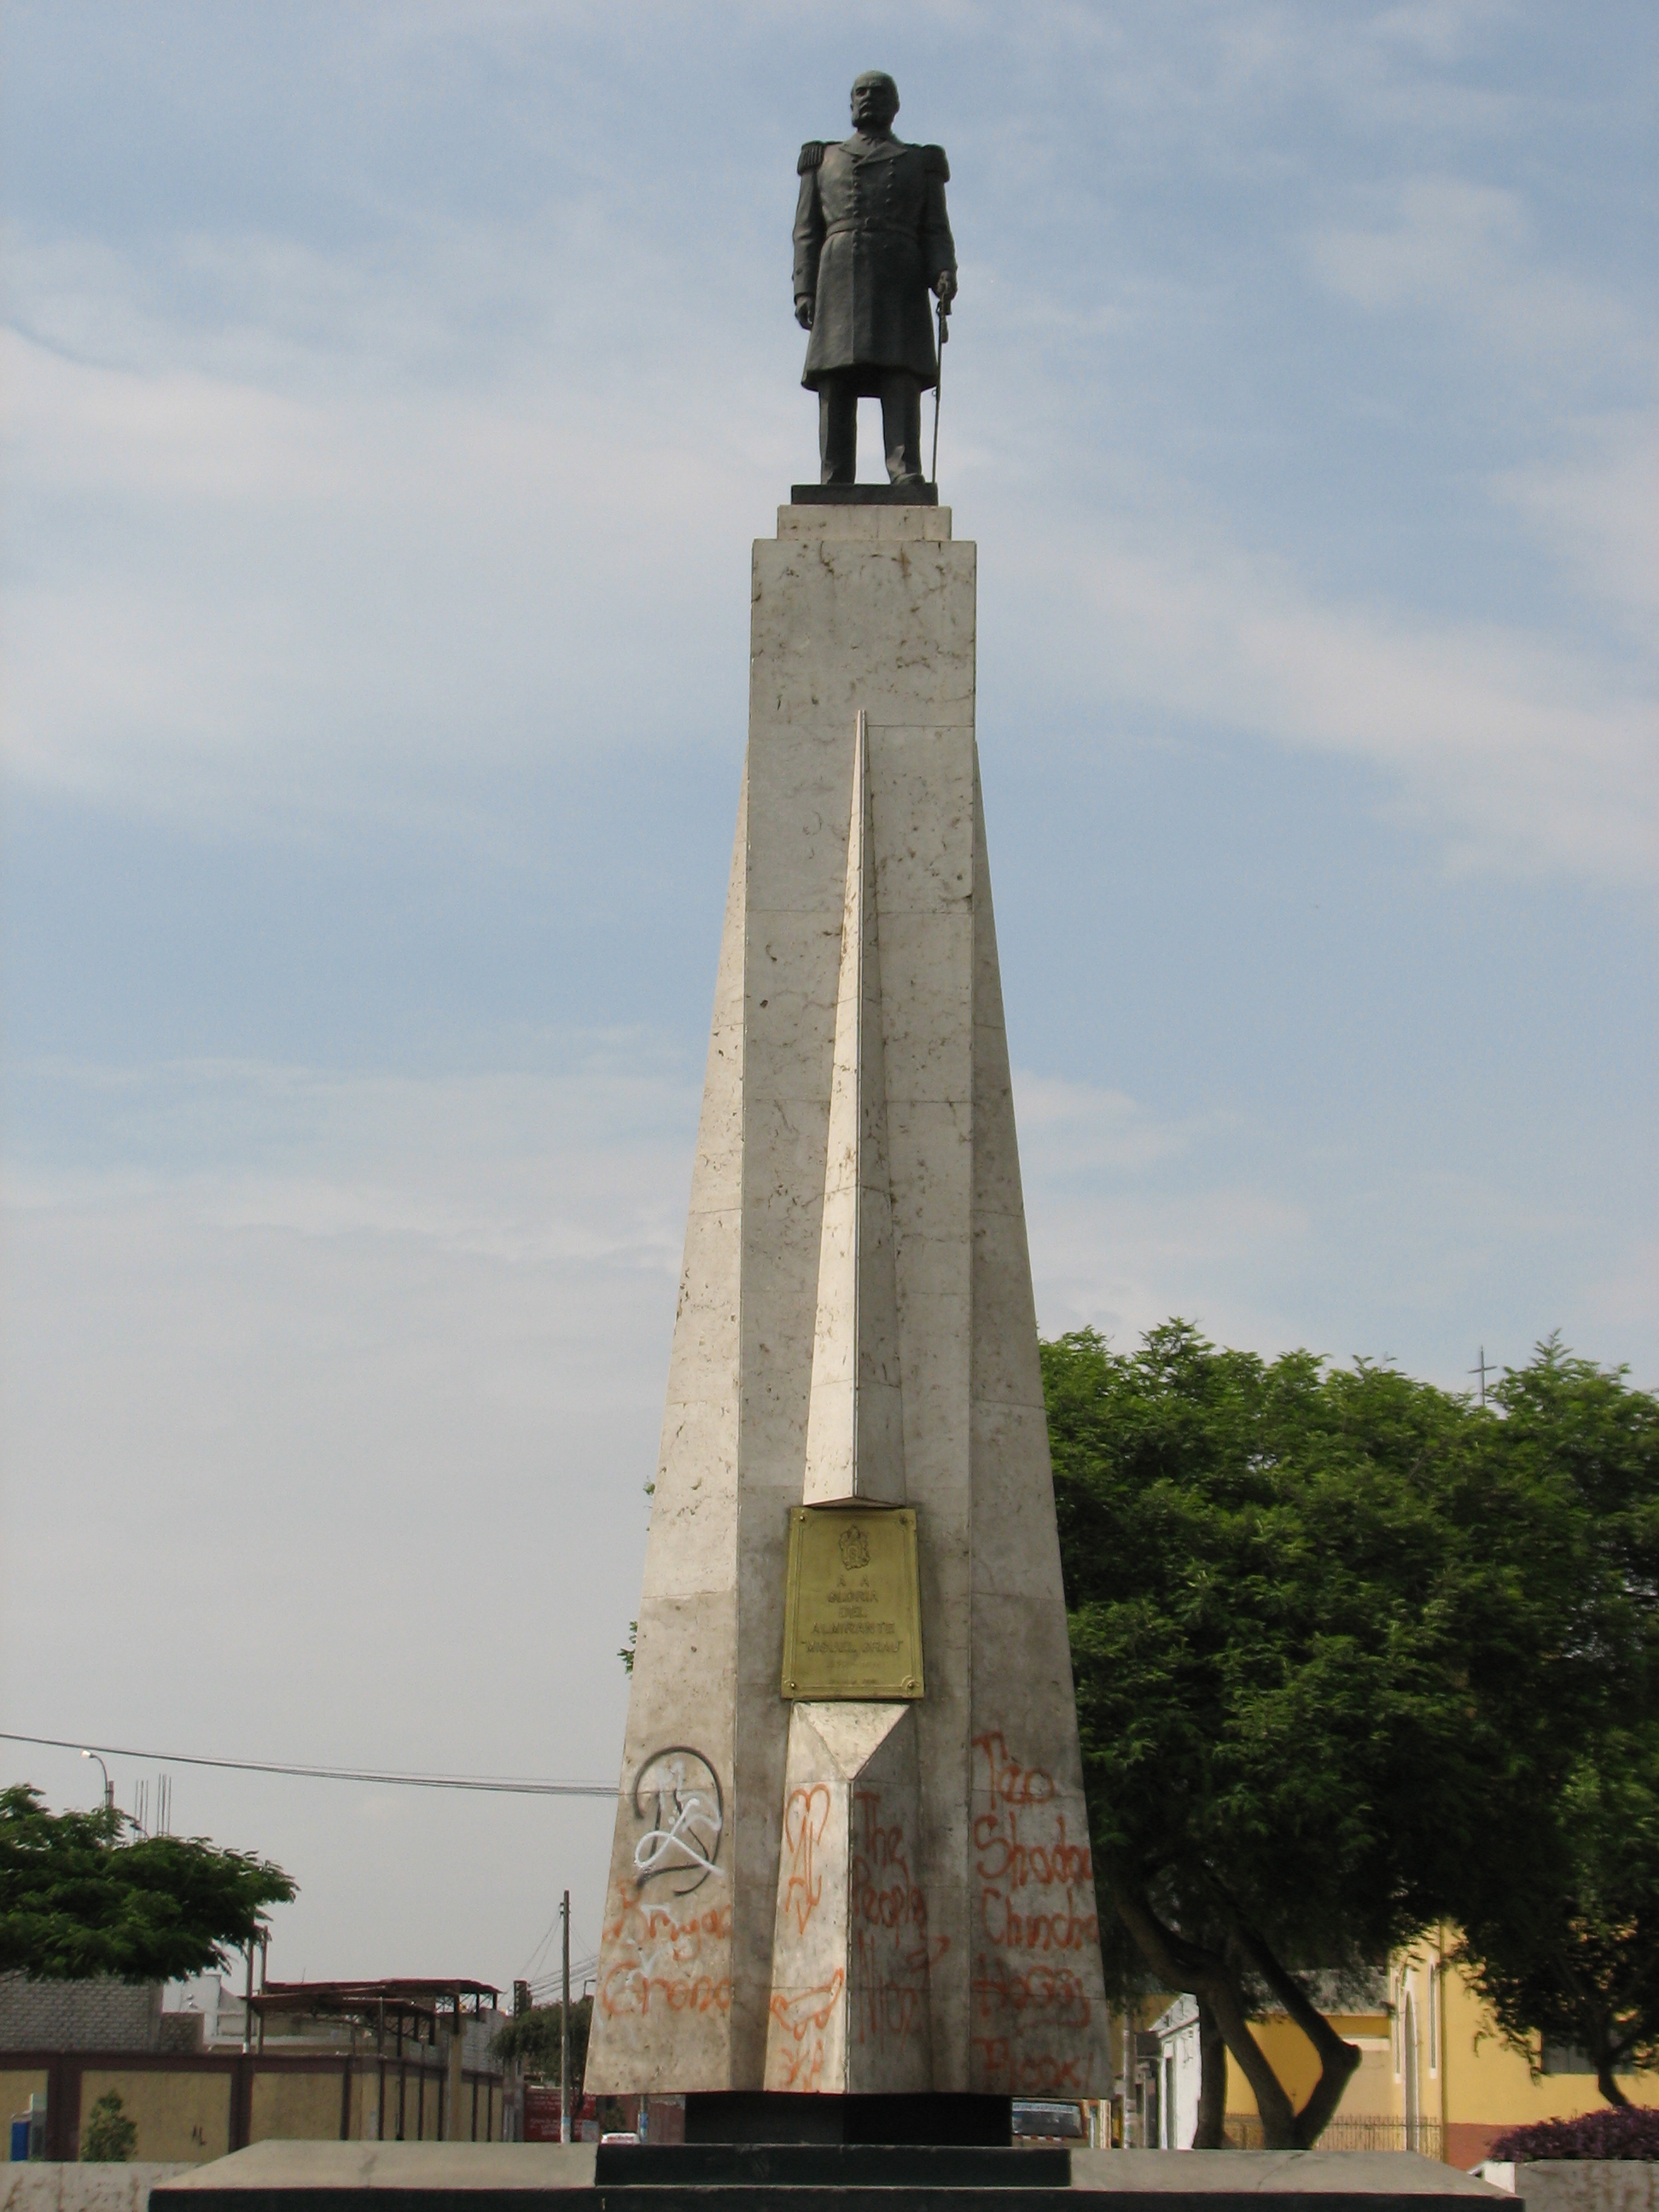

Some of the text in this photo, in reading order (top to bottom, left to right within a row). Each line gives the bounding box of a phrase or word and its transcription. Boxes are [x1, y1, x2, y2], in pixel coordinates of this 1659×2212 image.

[828, 1590, 879, 1603] GLORIA
[839, 1606, 867, 1618] DEL
[812, 1621, 895, 1633] ALMIRANTE
